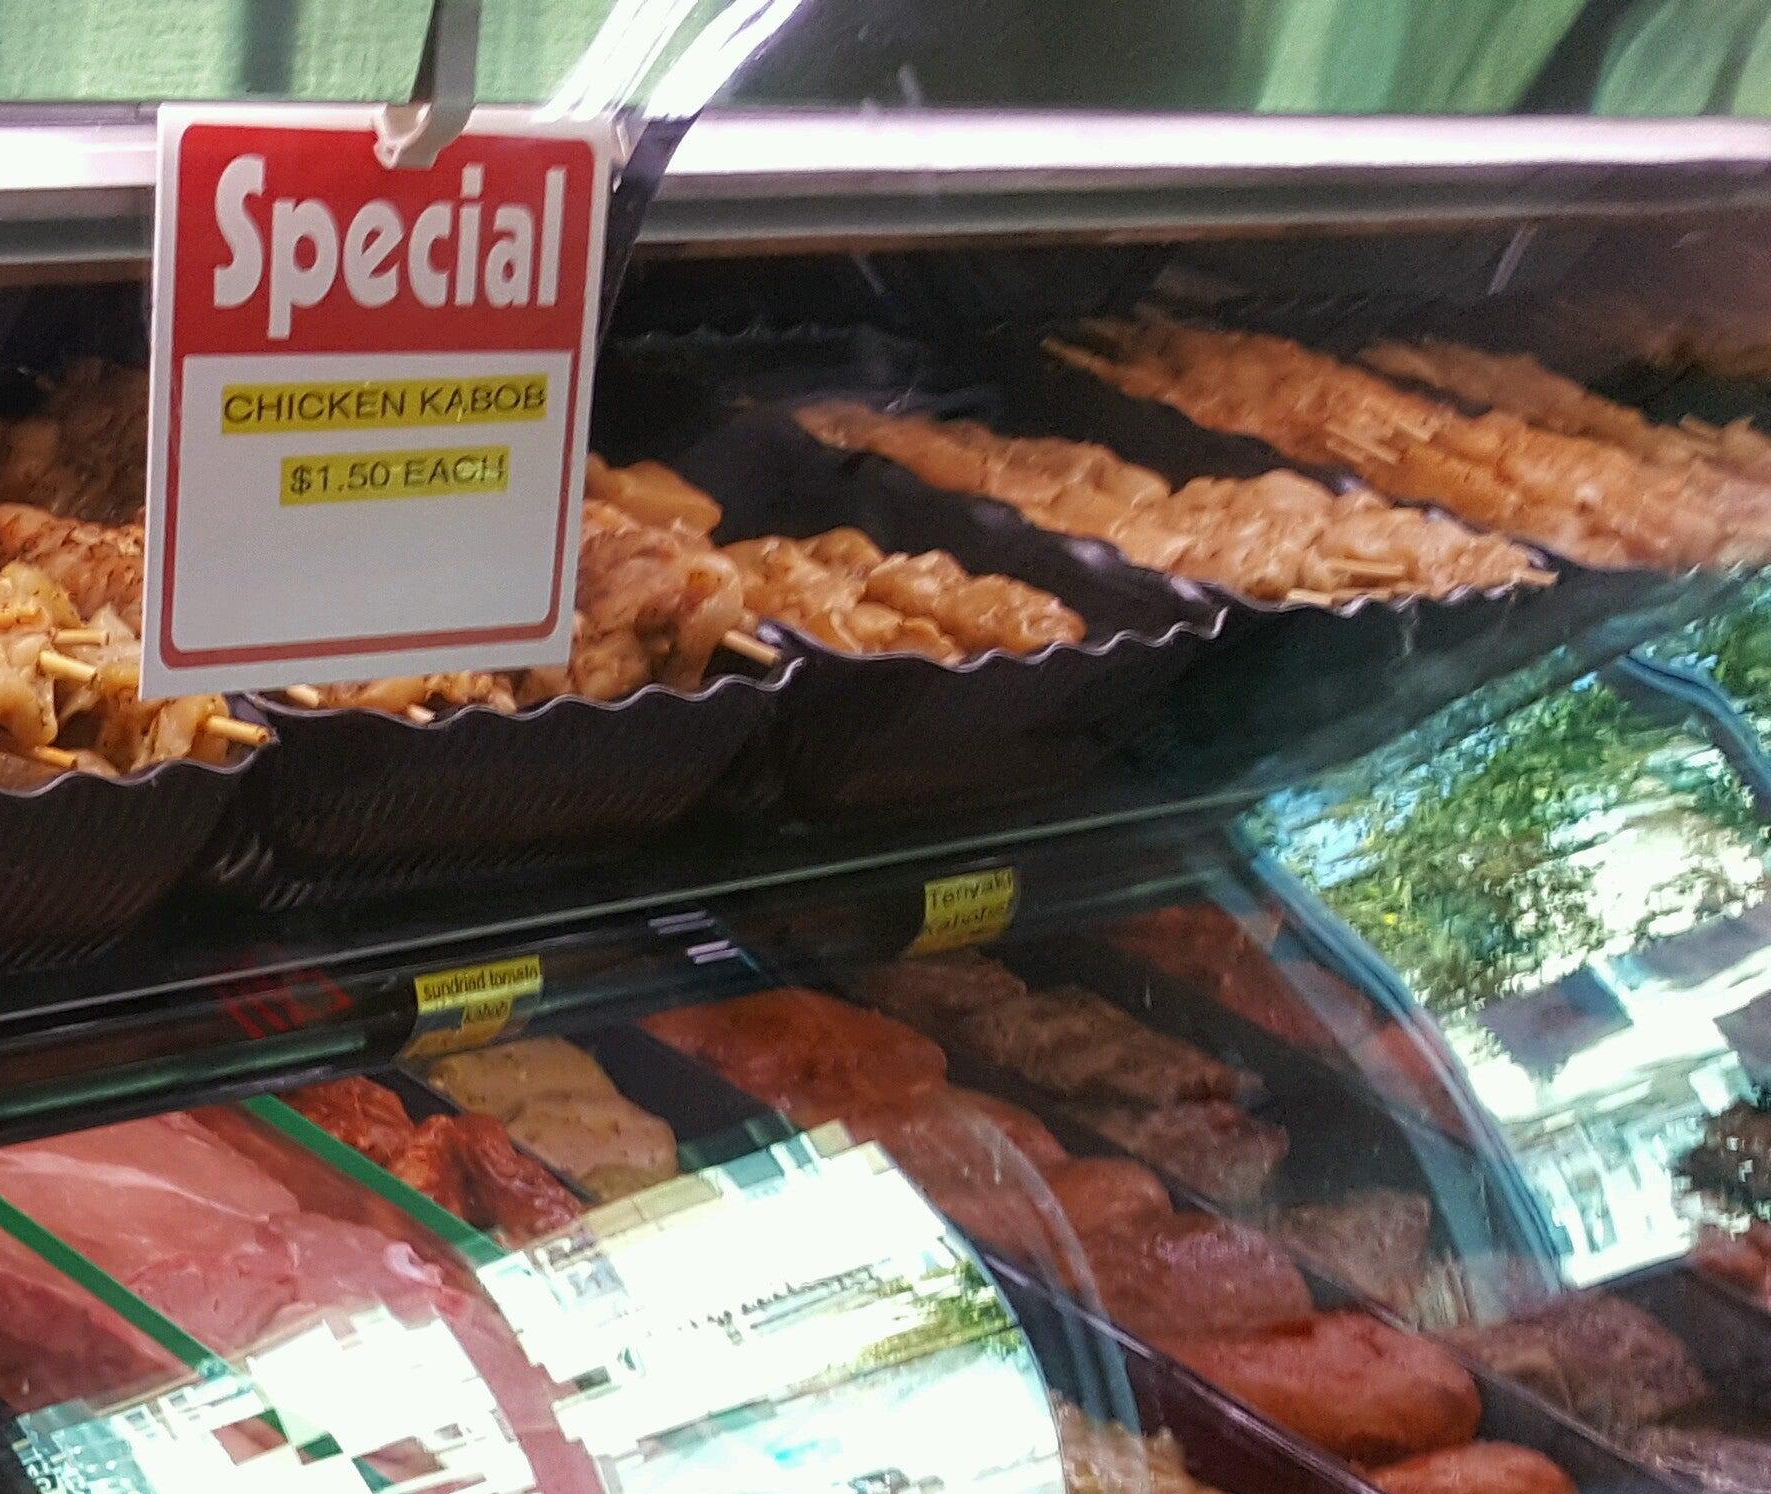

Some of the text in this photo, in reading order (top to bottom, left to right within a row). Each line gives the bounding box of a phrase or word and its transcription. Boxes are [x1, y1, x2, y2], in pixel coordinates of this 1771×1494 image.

[213, 153, 567, 341] Special
[223, 381, 546, 424] CHICKEN KABOB
[288, 453, 506, 495] $1.50 EACH
